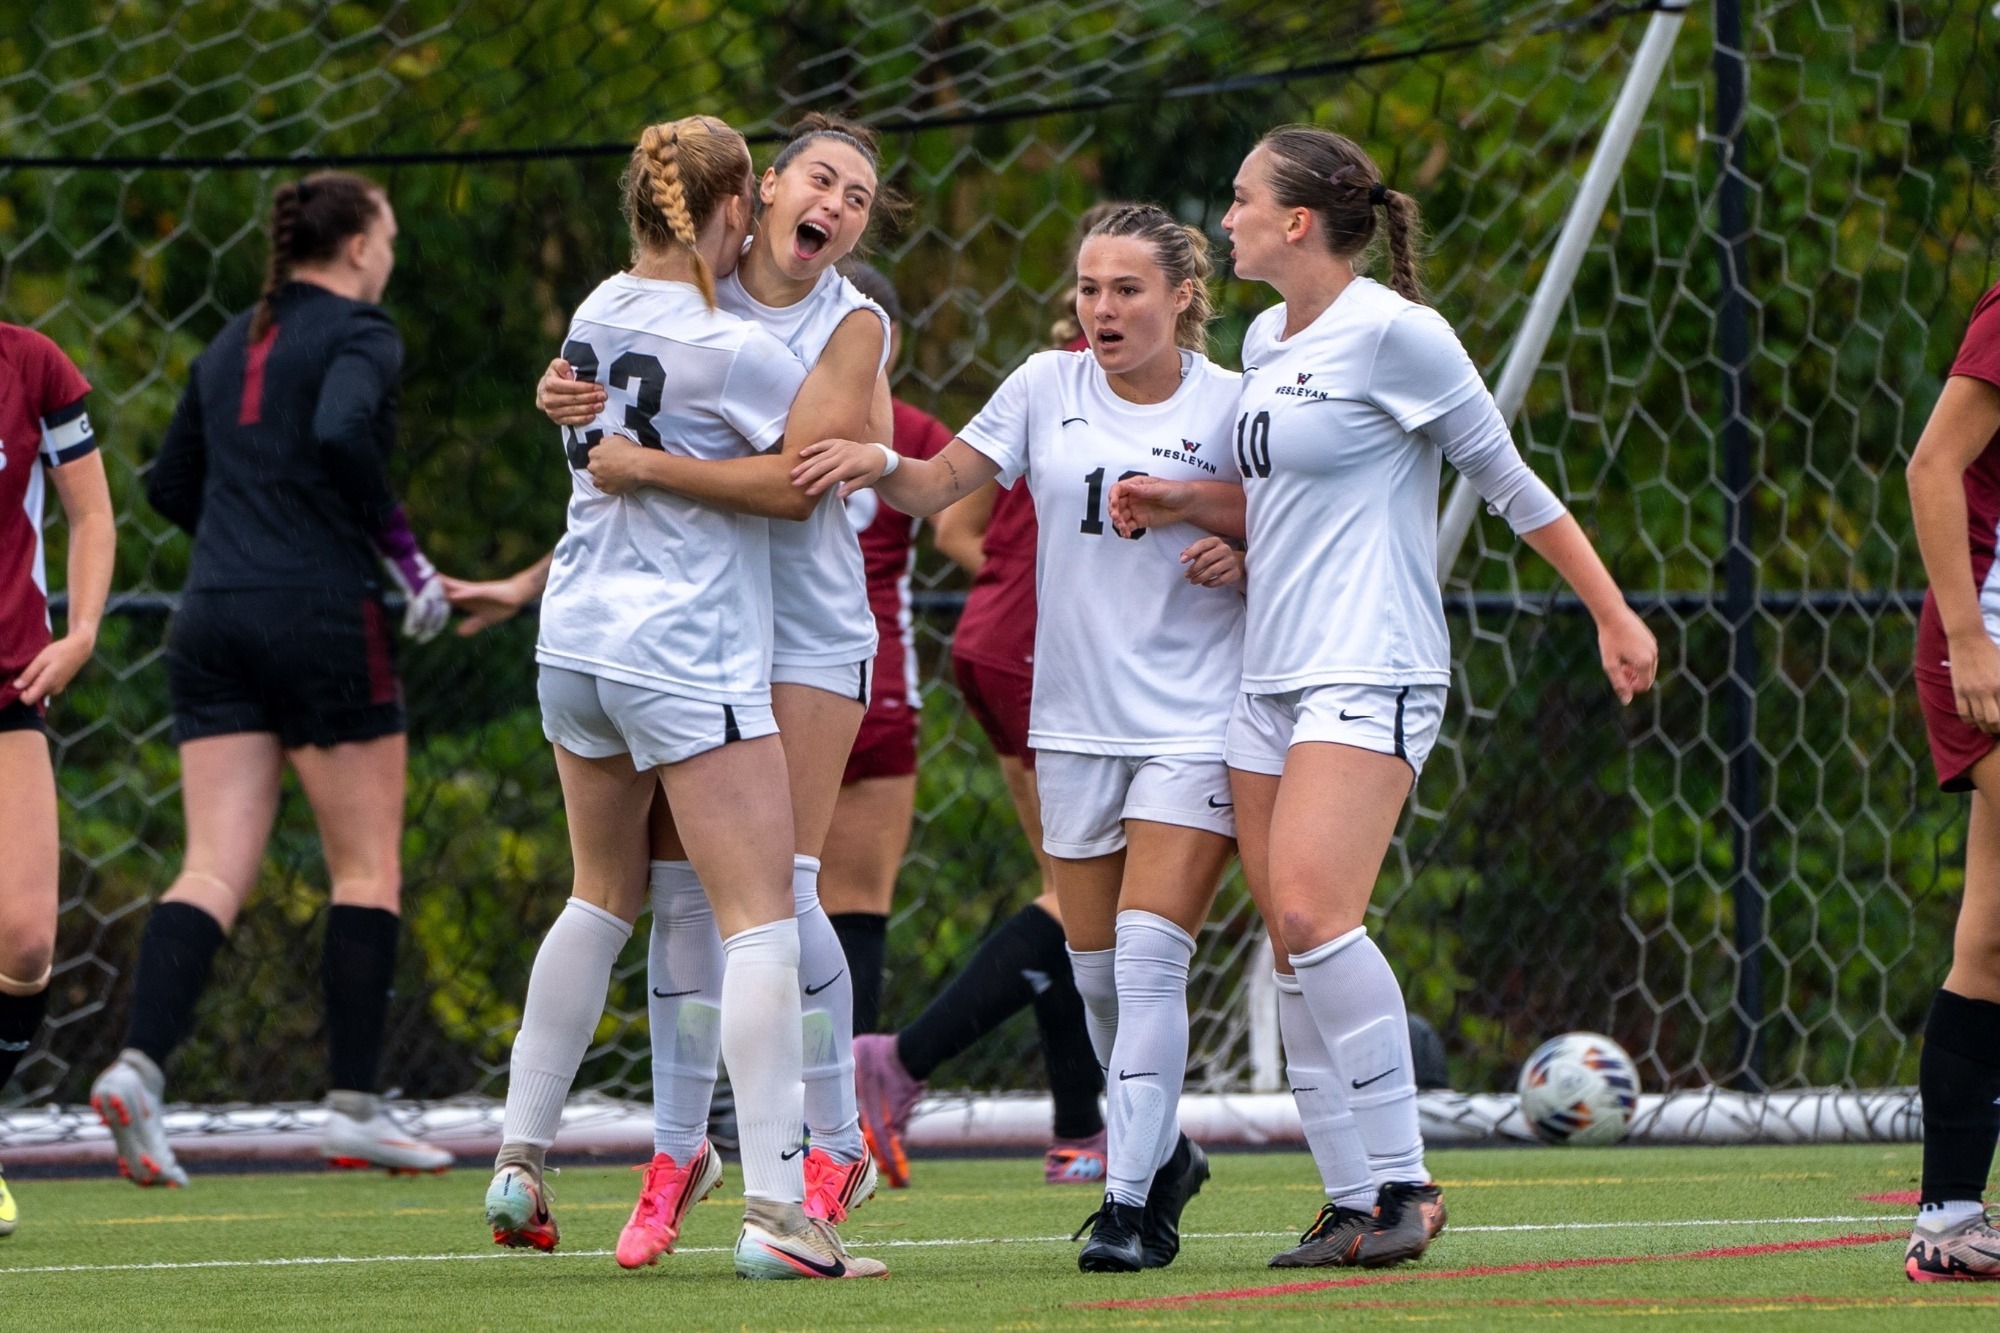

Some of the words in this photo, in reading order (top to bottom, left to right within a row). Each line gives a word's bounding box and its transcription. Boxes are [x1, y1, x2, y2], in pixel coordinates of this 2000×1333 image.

[1274, 386, 1329, 400] WESLEYAN
[1238, 411, 1272, 478] 10
[1152, 447, 1217, 475] WESLEYAN
